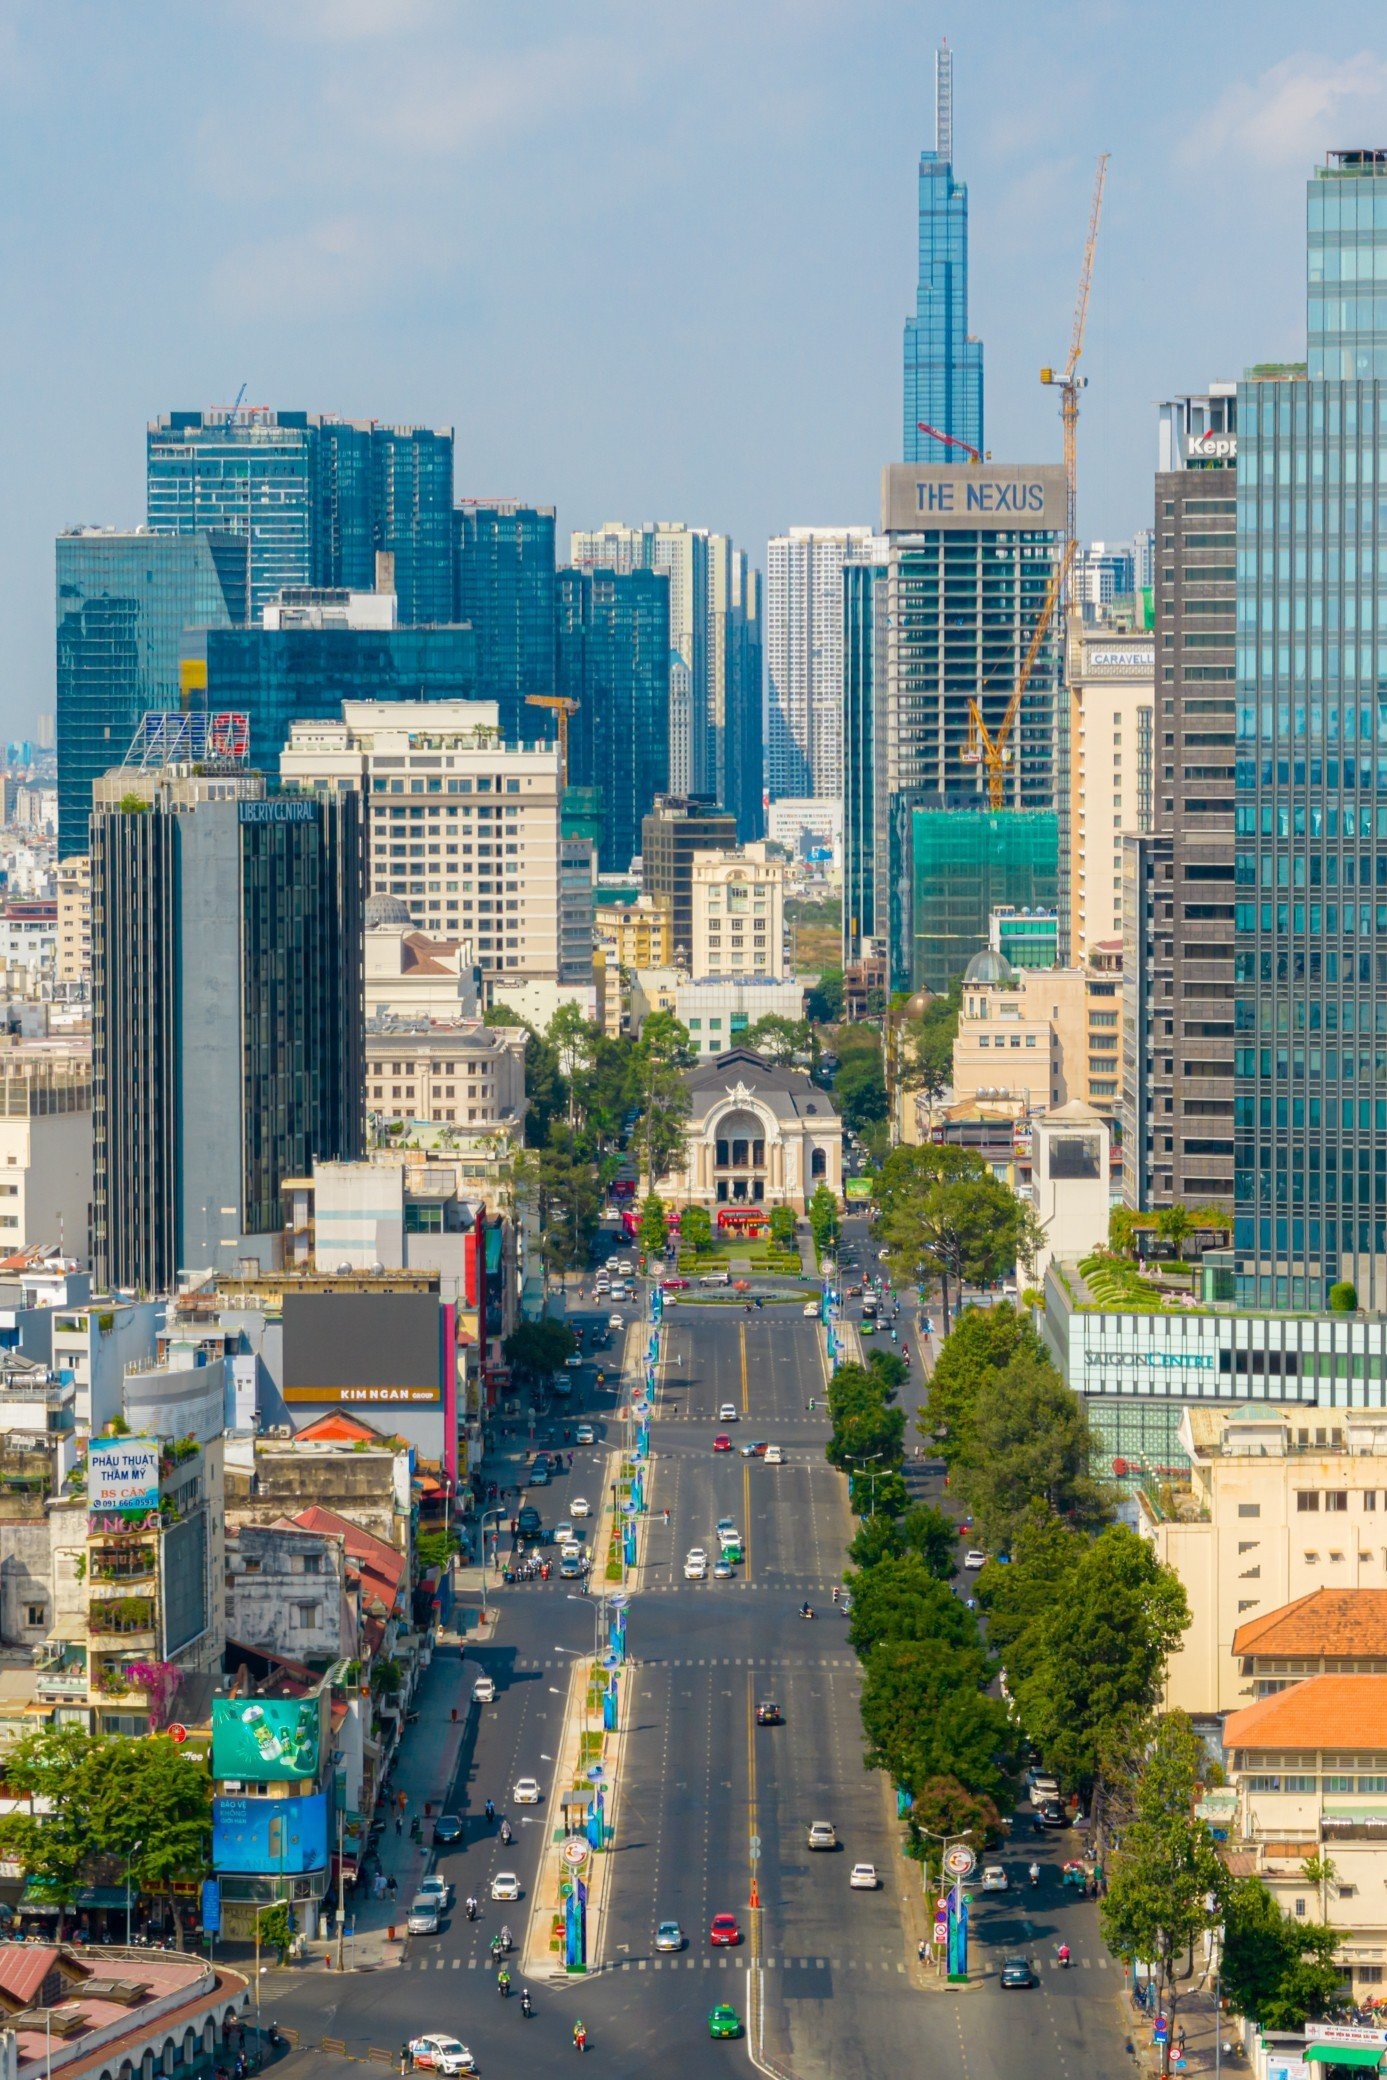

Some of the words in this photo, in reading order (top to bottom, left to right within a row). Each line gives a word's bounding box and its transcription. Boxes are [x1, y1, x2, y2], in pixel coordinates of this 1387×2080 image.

[917, 483, 953, 510] THE
[967, 483, 1043, 511] NEXUS
[1094, 654, 1154, 664] CARAVELL
[341, 1390, 366, 1399] KIM
[369, 1390, 408, 1399] NGAN
[101, 1489, 116, 1498] BS
